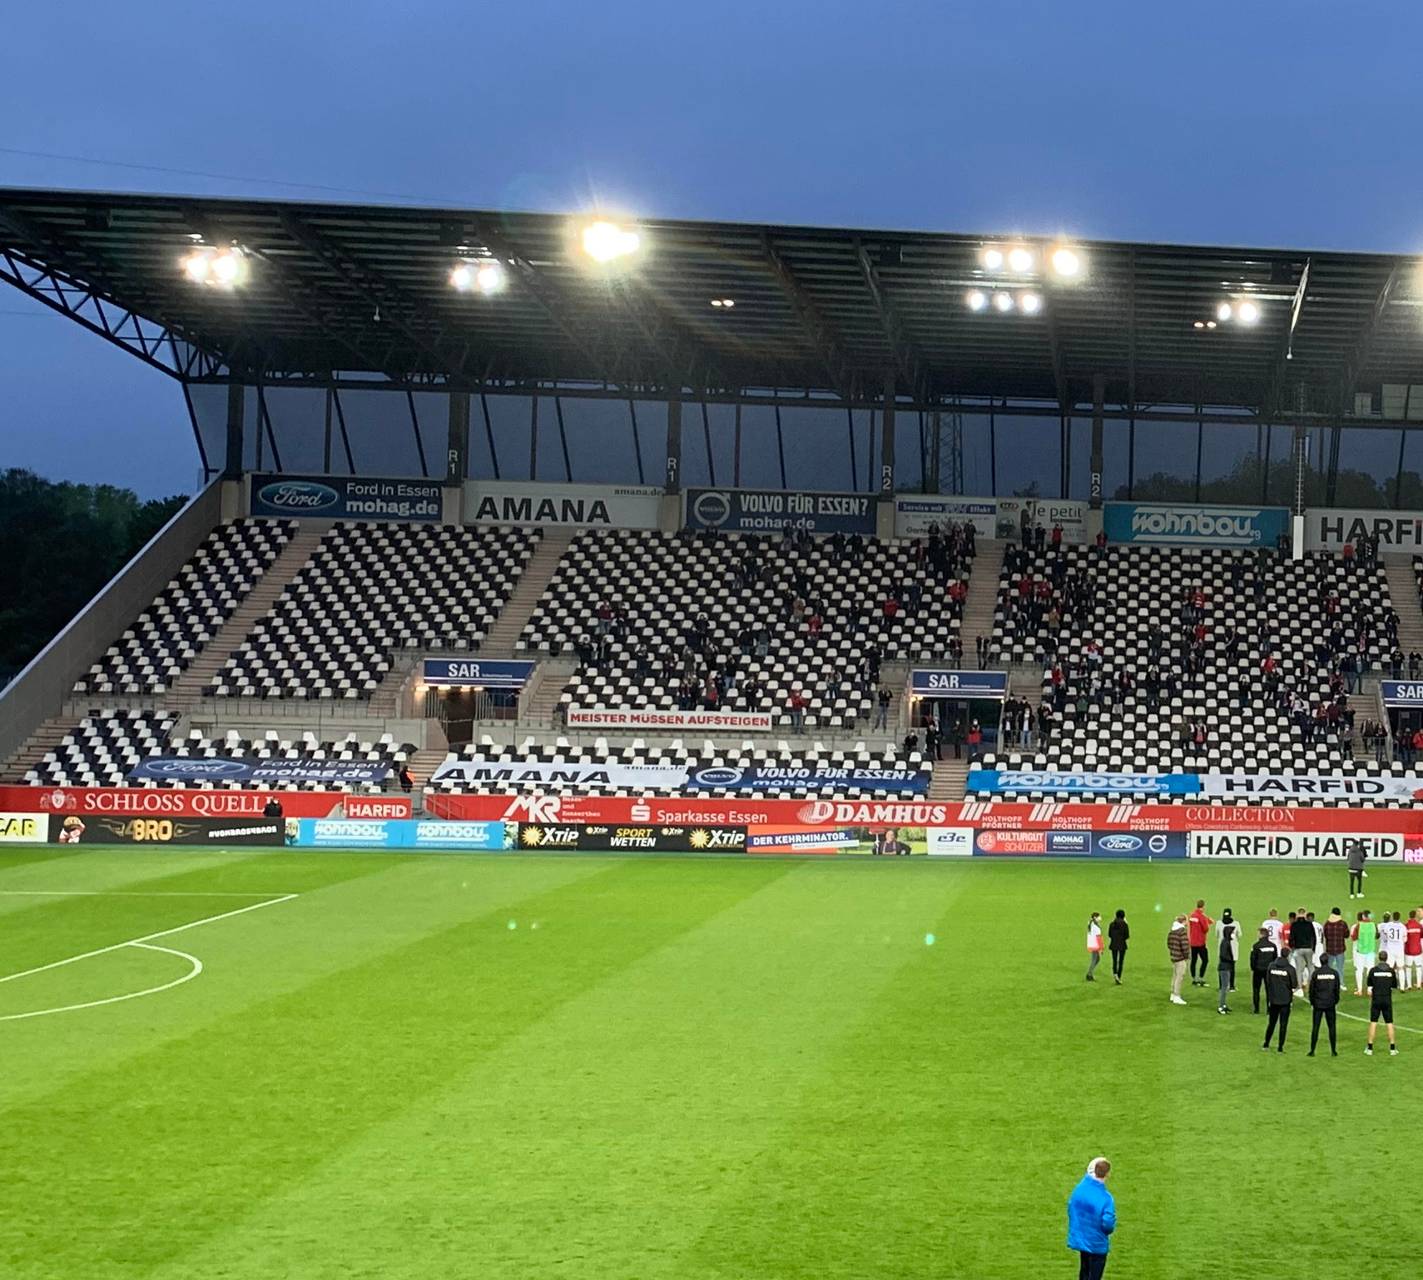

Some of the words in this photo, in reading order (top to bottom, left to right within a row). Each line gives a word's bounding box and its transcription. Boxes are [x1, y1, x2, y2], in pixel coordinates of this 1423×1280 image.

[273, 485, 322, 507] Ford
[346, 483, 378, 495] Ford
[398, 485, 439, 497] Essen
[346, 498, 439, 516] mohag.de
[475, 496, 611, 523] AMANA
[740, 494, 783, 513] VOLVO
[788, 494, 813, 515] FÜR
[818, 497, 868, 516] ESSEN?
[1050, 506, 1081, 520] petit
[449, 663, 479, 677] SAR
[928, 674, 959, 688] SAR
[571, 713, 627, 723] MEISTER
[631, 713, 684, 725] MÜSSEN
[688, 715, 769, 726] AUFSTEIGEN
[261, 759, 302, 767] Ford
[253, 768, 373, 778] mohag.de
[434, 768, 611, 783] AMANA
[757, 767, 810, 778] VOLVO
[815, 767, 847, 779] FÜR
[853, 769, 916, 780] ESSEN?
[84, 792, 184, 812] SCHLOSS
[349, 804, 407, 817] HARFID
[657, 809, 724, 824] Sparkasse
[728, 811, 768, 823] Essen
[834, 804, 947, 823] DAMHUS
[1185, 807, 1295, 822] COLLECTION
[616, 828, 653, 838] SPORT
[753, 835, 774, 846] DER
[776, 832, 848, 845] KEHRMINATOR.
[996, 832, 1044, 842] KULTURGUT
[1053, 835, 1084, 844] MOHAG
[610, 837, 656, 847] WETTEN
[1107, 838, 1134, 849] Ford
[1389, 927, 1400, 939] 31
